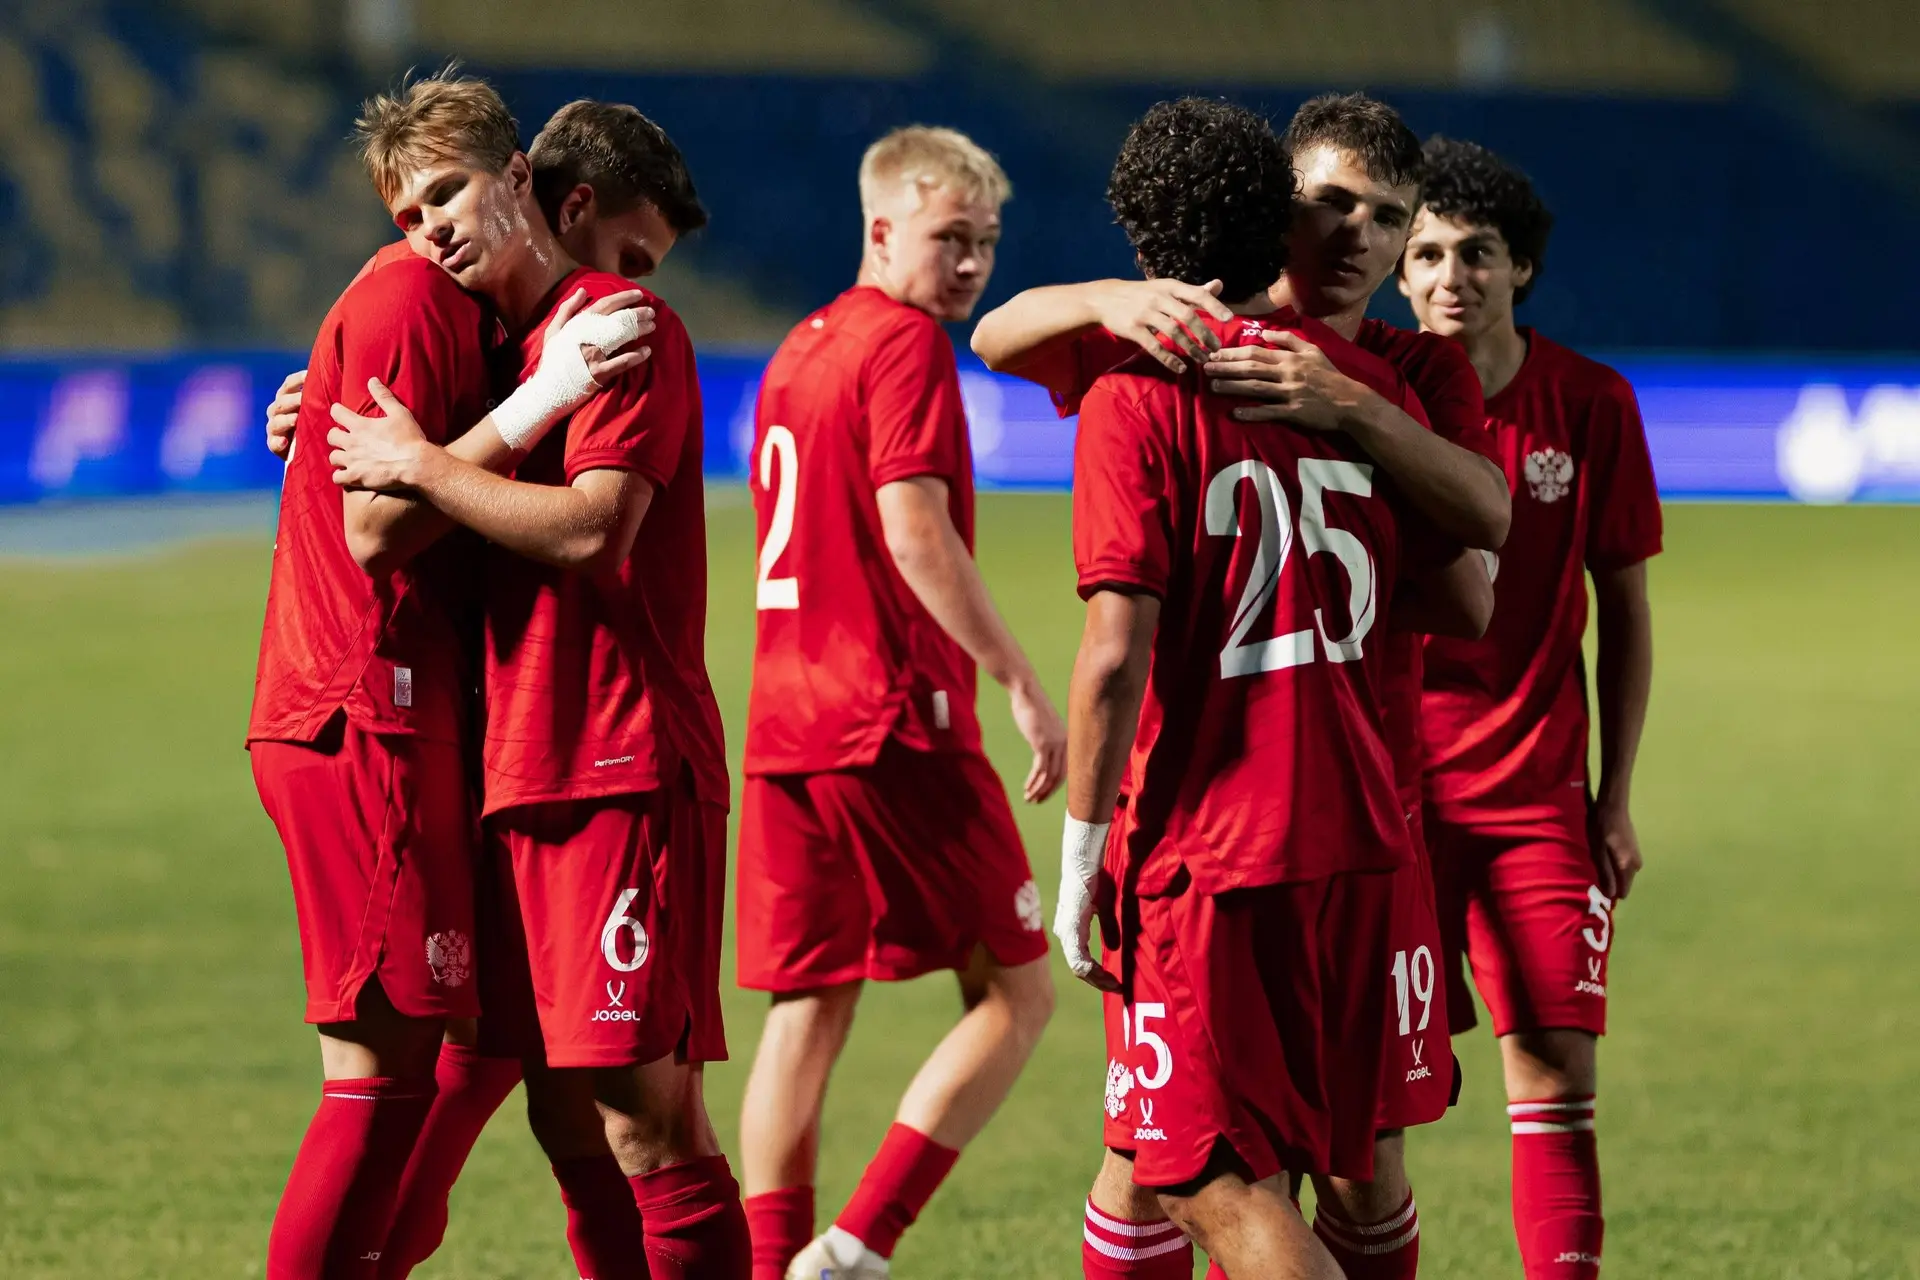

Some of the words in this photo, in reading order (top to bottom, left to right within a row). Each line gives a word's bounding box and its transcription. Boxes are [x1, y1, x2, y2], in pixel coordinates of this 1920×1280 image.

[757, 425, 799, 610] 2
[1205, 458, 1376, 680] 25
[601, 888, 649, 972] 6
[1583, 884, 1612, 953] 5
[1391, 945, 1435, 1036] 19
